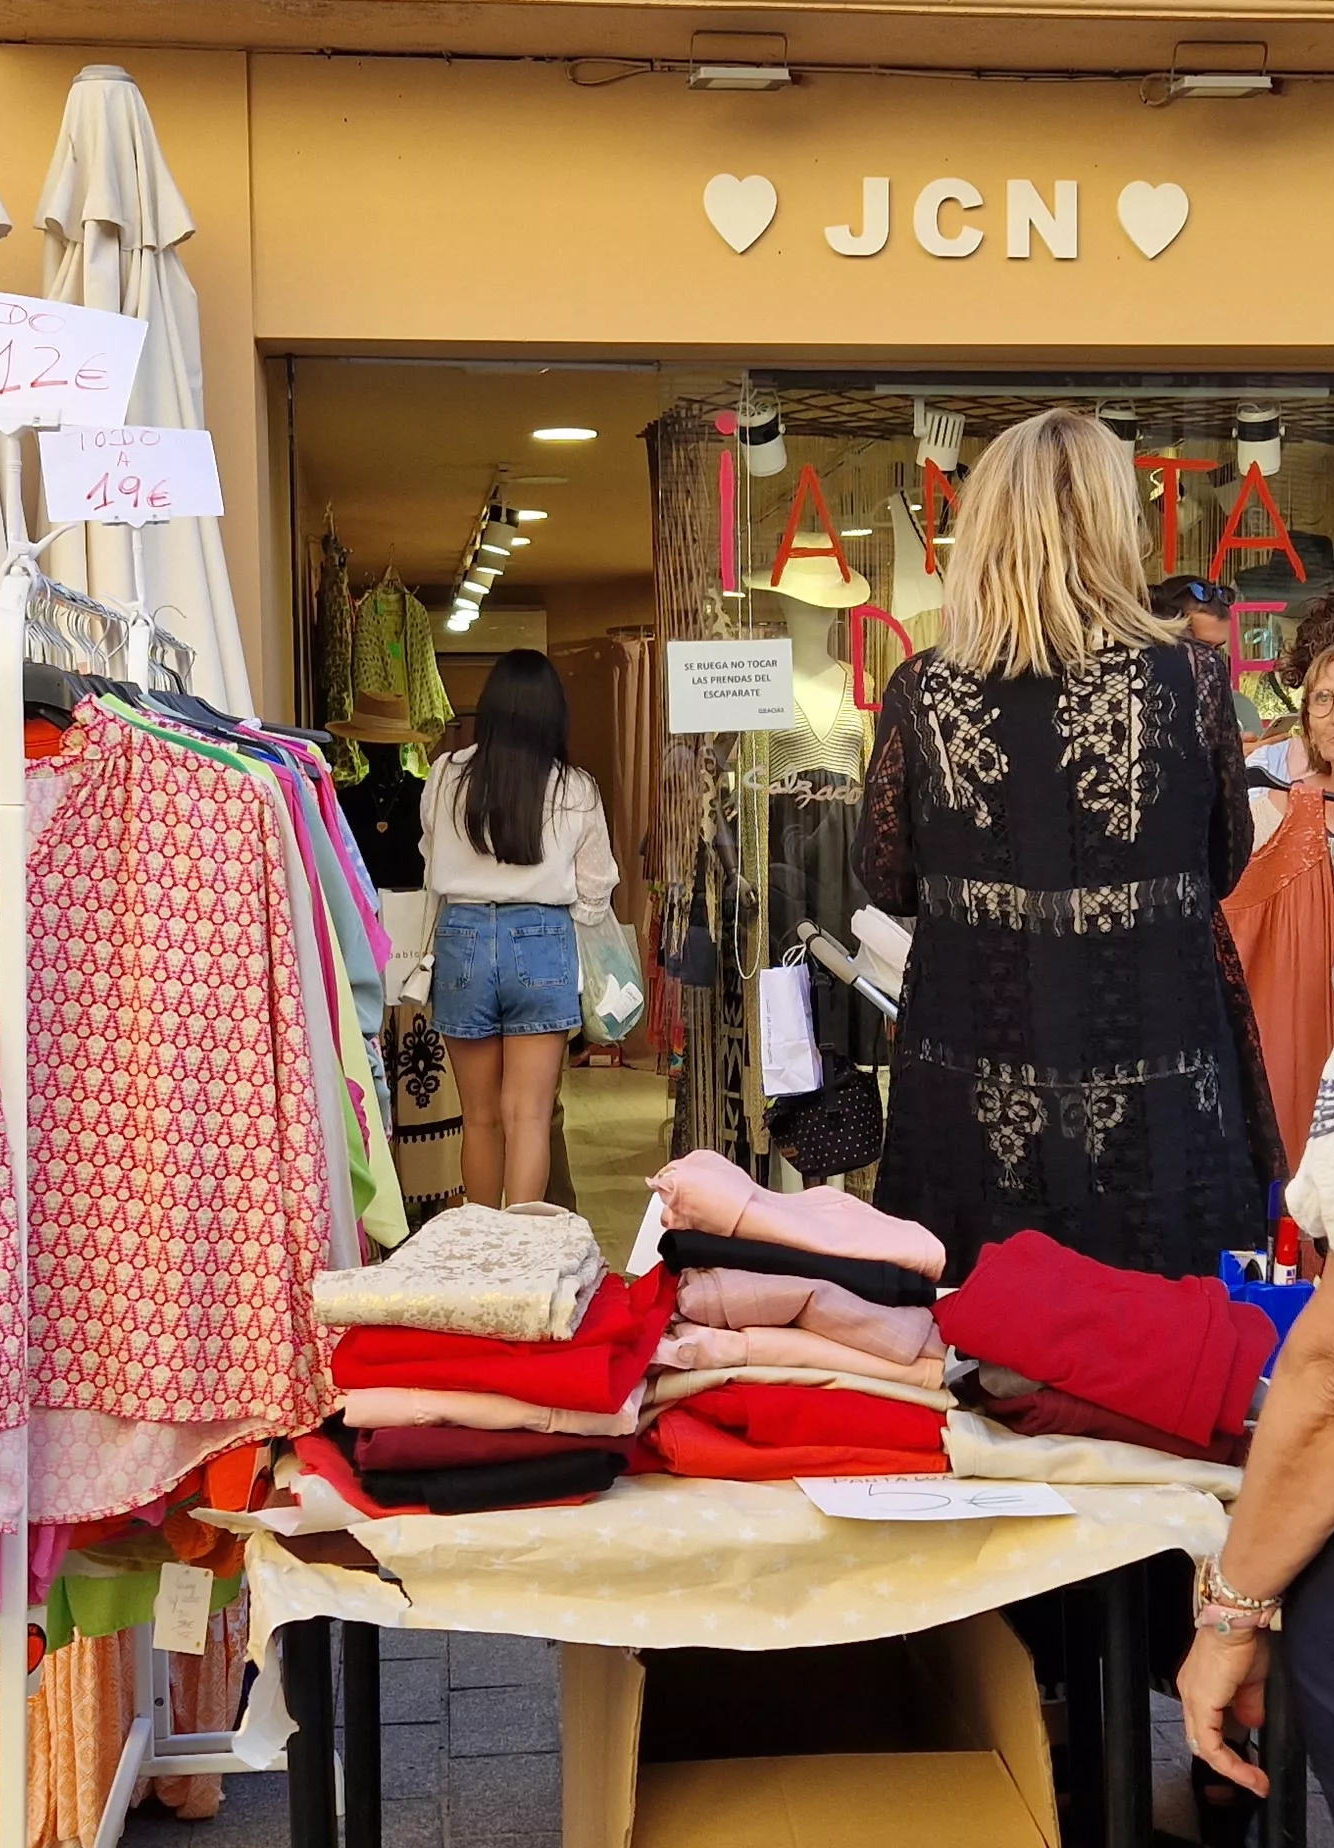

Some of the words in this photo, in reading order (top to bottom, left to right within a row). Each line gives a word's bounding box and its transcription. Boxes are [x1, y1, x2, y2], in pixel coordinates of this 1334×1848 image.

[823, 176, 1079, 260] JCN
[116, 450, 131, 468] A
[85, 472, 172, 511] 19€
[684, 662, 695, 671] SE
[697, 661, 728, 671] RUEGA
[731, 660, 745, 669] NO
[748, 659, 778, 669] TOCAR
[692, 676, 708, 685] LAS
[711, 674, 753, 684] PRENDAS
[755, 673, 771, 683] DEL
[703, 688, 760, 699] ESCAPARATE
